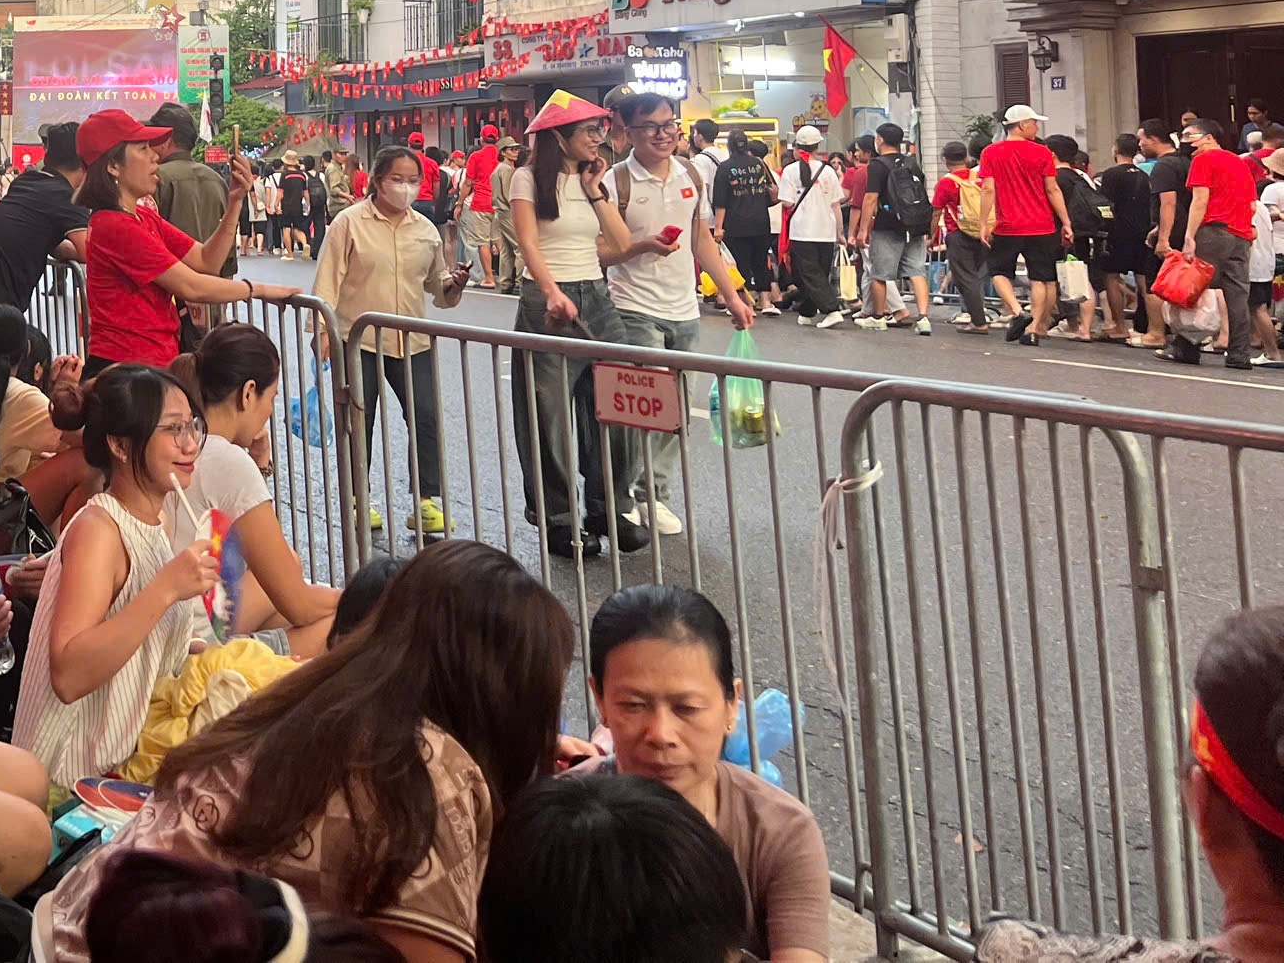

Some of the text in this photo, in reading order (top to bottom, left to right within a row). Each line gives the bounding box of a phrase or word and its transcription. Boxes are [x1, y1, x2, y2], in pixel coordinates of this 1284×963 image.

[627, 45, 684, 58] Ba Tahu
[1052, 78, 1062, 88] 37
[29, 92, 52, 103] ĐẠI
[58, 90, 91, 101] ĐOÀN
[96, 89, 118, 100] KẾT
[124, 90, 156, 101] TOÀN
[617, 372, 655, 388] POLICE
[613, 391, 663, 418] STOP
